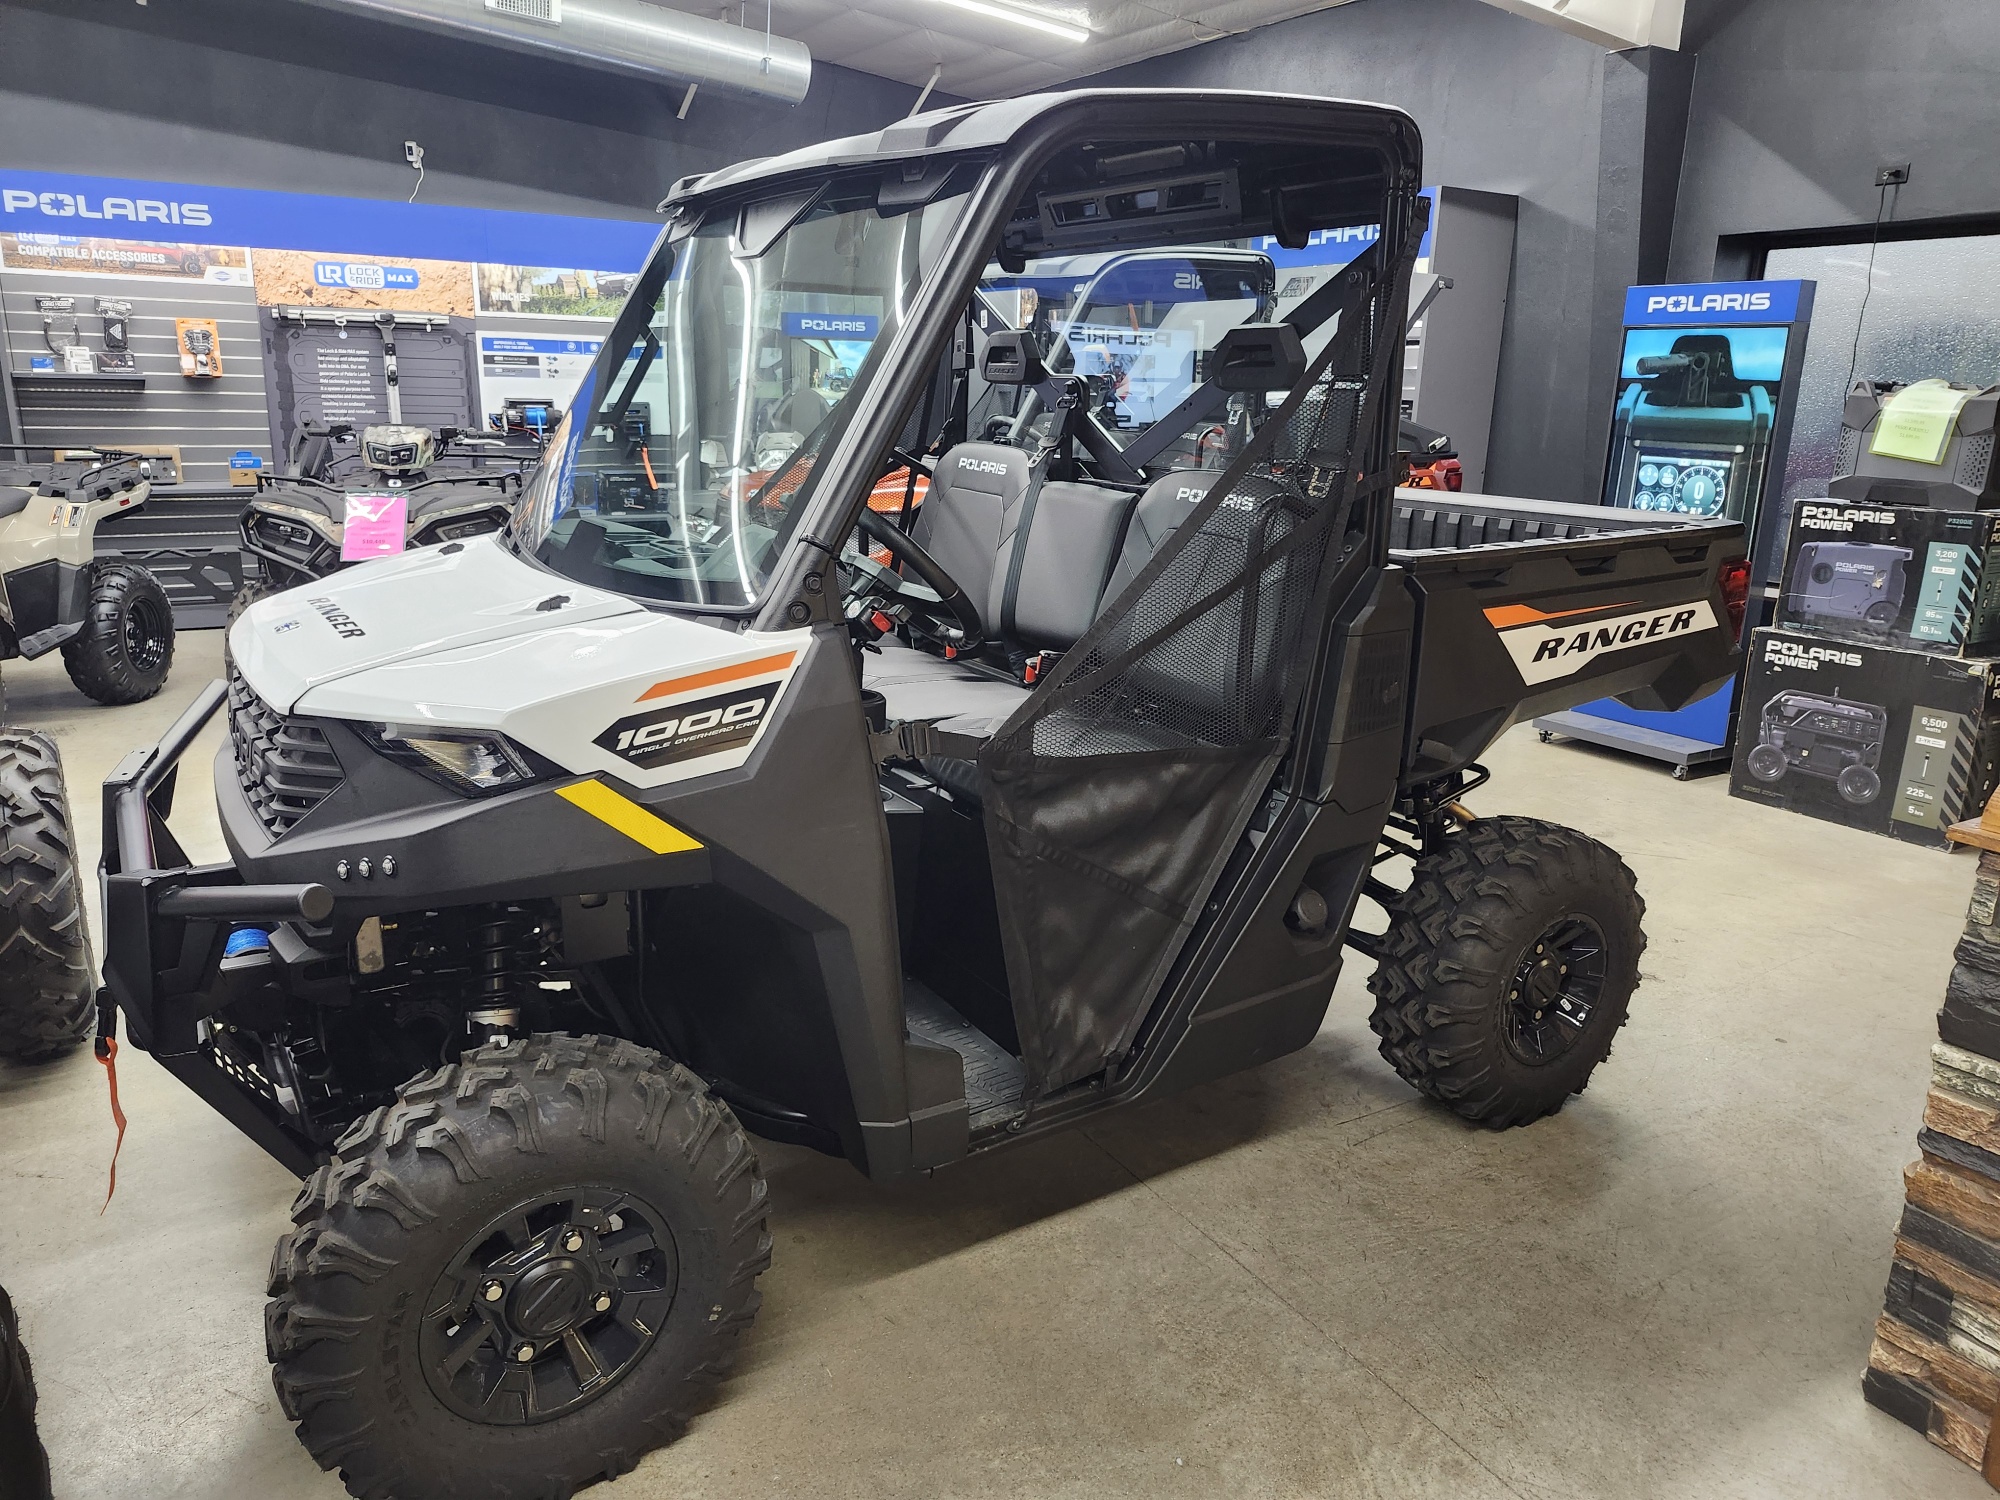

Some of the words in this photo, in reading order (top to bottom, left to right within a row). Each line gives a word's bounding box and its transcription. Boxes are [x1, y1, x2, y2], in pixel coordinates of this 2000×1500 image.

[2, 189, 213, 227] POLARIS
[18, 244, 90, 259] COMPATIBLE
[91, 247, 166, 264] ACCESSORIES
[349, 267, 380, 276] LOCK
[387, 274, 414, 283] MAX
[490, 290, 531, 302] WINCHES
[1646, 292, 1771, 313] POLARIS
[801, 319, 866, 332] POLARIS
[959, 457, 1007, 475] POLARIS
[1801, 506, 1896, 525] POLARIS
[1800, 518, 1854, 532] POWER
[1935, 549, 1958, 559] 3,200
[1835, 566, 1858, 574] POWER
[1836, 561, 1875, 571] POLARIS
[307, 597, 366, 639] RANGER
[1925, 610, 1935, 618] 95
[1531, 609, 1696, 663] RANGER
[1920, 625, 1934, 634] 10.1
[1766, 639, 1863, 667] POLARIS
[1764, 652, 1819, 671] POWER
[615, 698, 766, 751] 1000
[1921, 716, 1948, 729] 6,500
[628, 741, 671, 757] SINGLE
[674, 725, 734, 745] OVERHEAD
[734, 719, 760, 730] CAM
[1906, 786, 1925, 798] 225
[1907, 805, 1915, 814] 5
